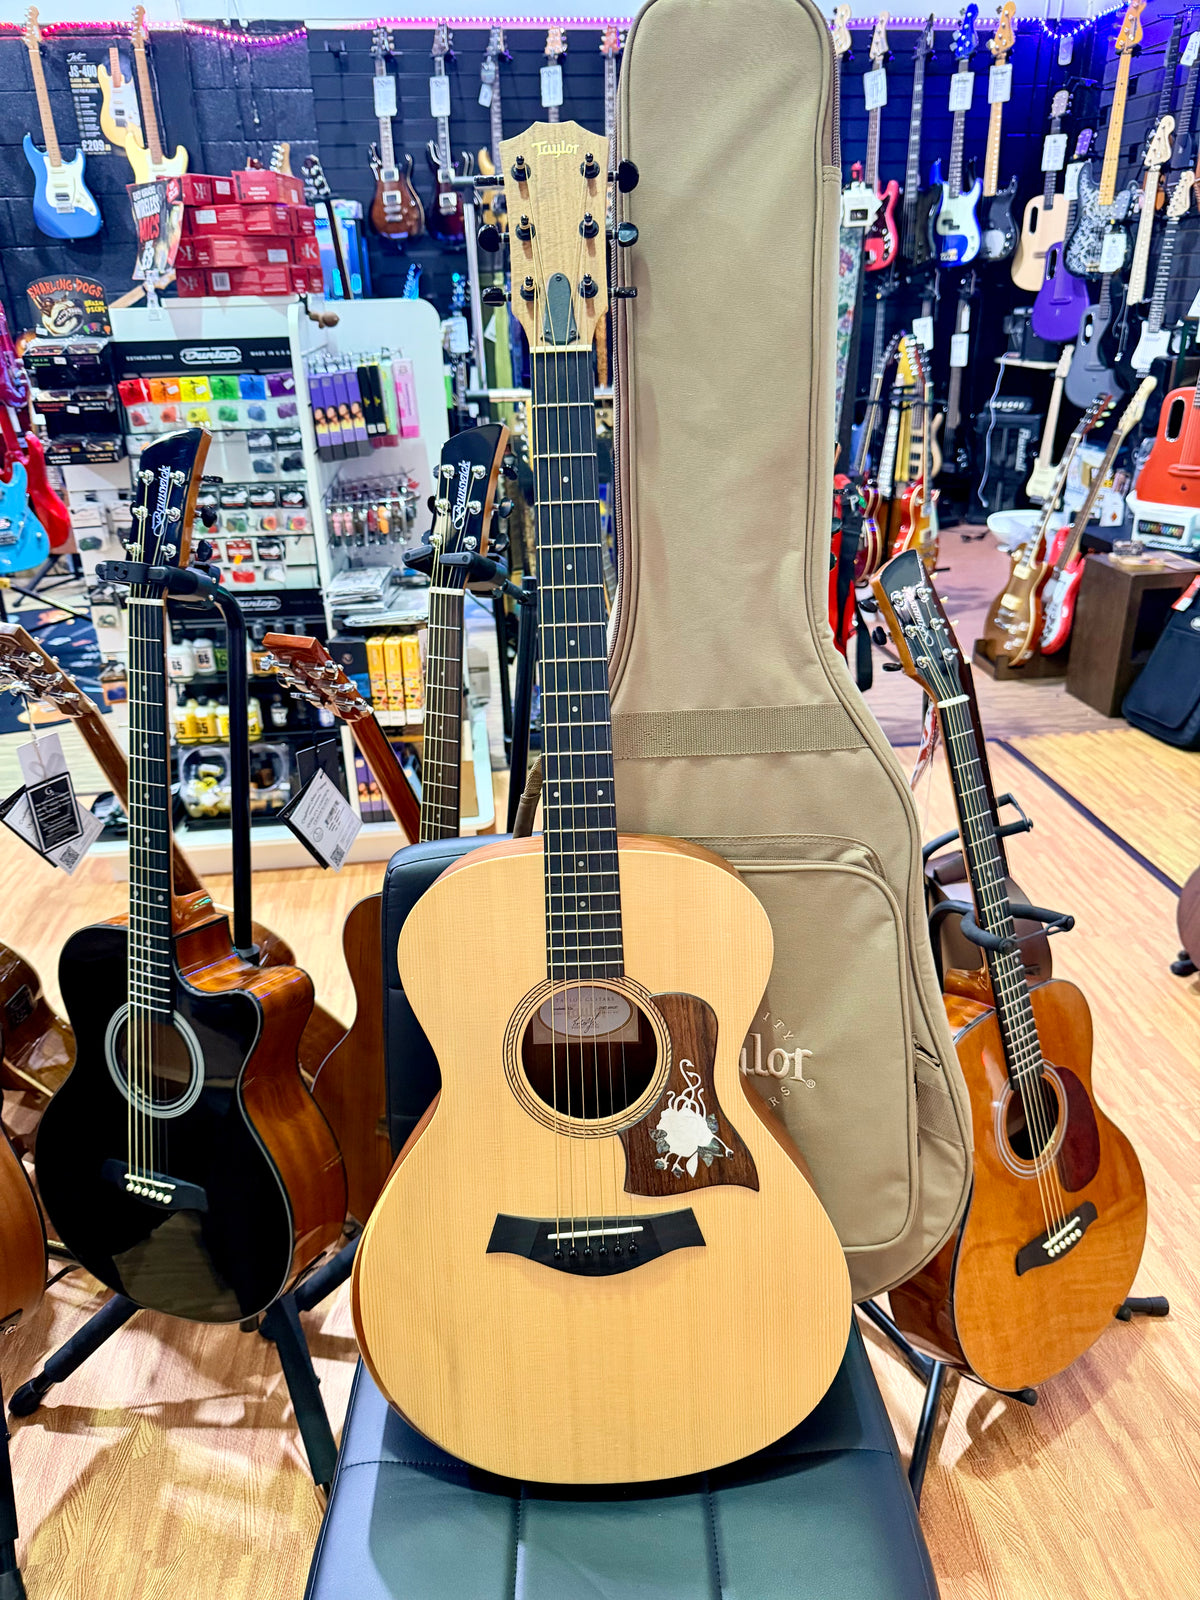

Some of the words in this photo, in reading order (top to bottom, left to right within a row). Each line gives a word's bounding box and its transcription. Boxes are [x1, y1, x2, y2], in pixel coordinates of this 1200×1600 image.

[68, 65, 97, 78] JS-400
[531, 140, 579, 160] Taylor
[26, 279, 73, 300] SNARLING
[186, 350, 239, 361] Dunlop
[151, 464, 171, 537] Brunswick
[452, 459, 471, 530] Brunswick
[240, 599, 277, 609] unlop
[763, 1012, 794, 1040] ITY
